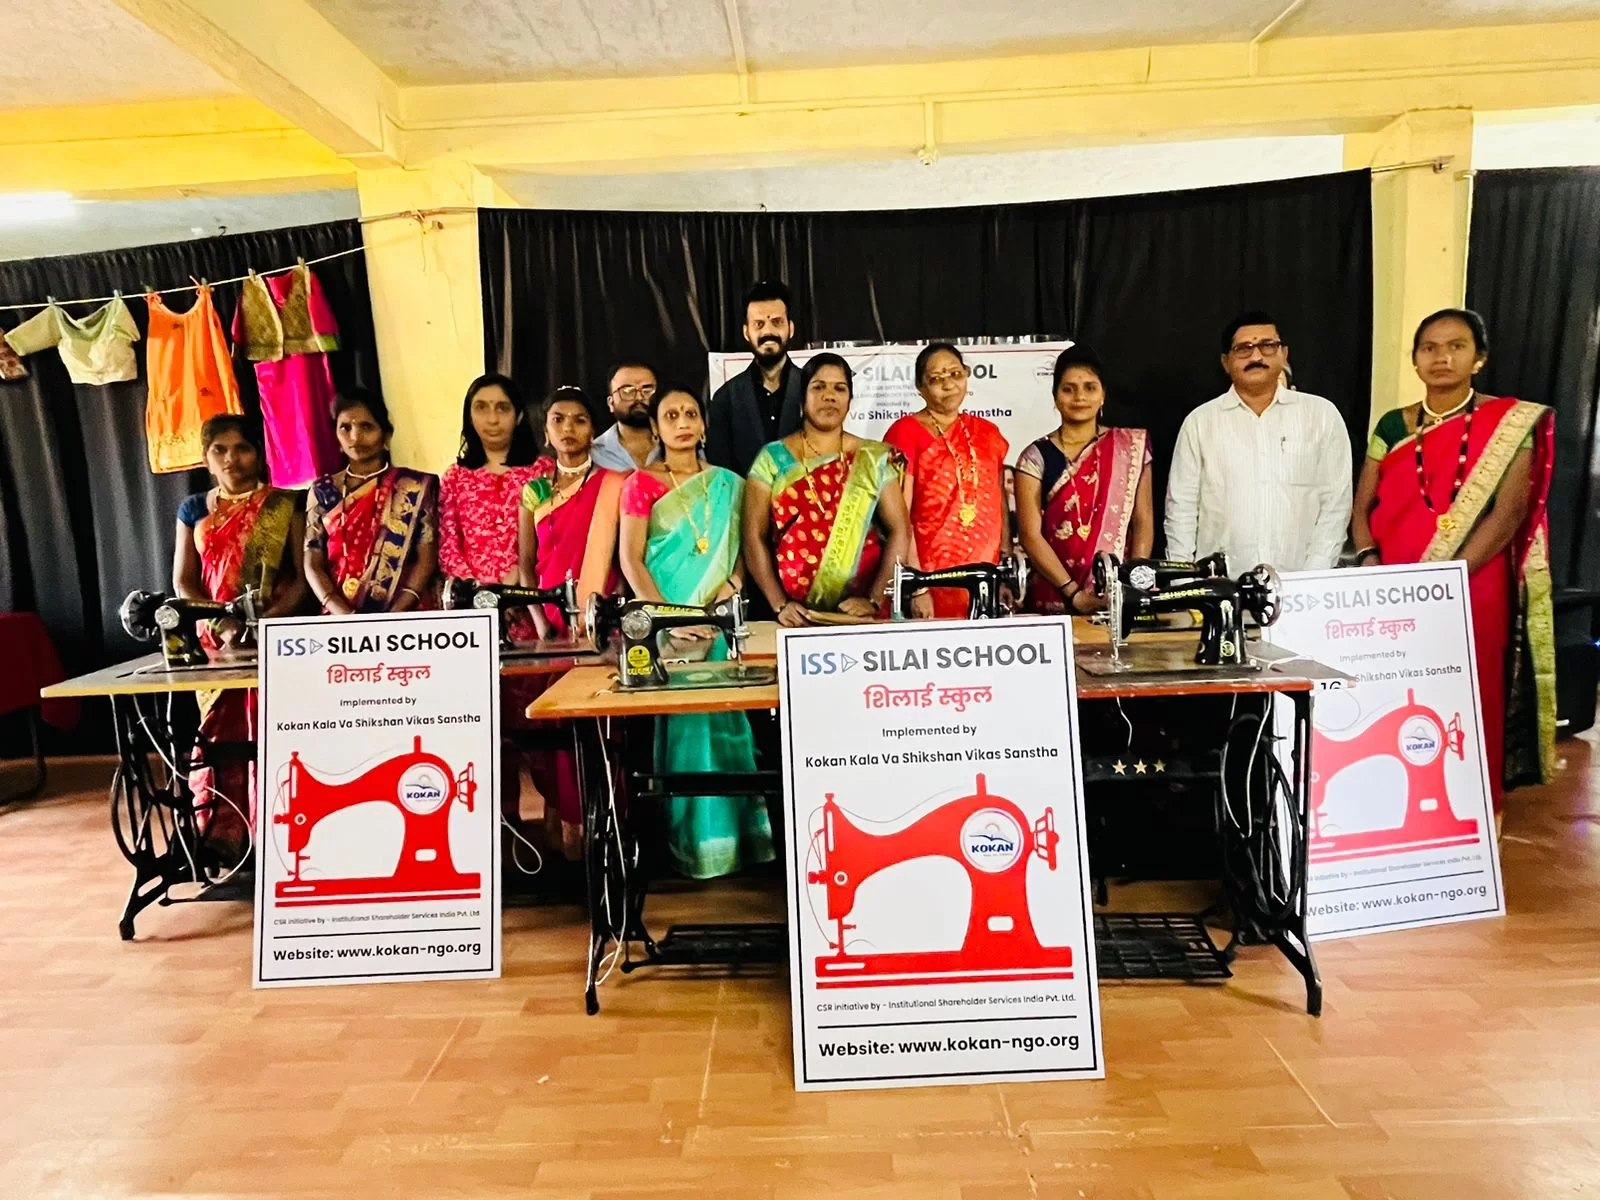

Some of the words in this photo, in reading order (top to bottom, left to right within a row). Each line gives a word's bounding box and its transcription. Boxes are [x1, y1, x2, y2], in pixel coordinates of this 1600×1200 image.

[863, 366, 911, 381] SILAI
[850, 411, 865, 420] Va
[1283, 594, 1305, 613] SS
[1323, 591, 1370, 610] SILAI
[1376, 583, 1454, 605] SCHOOL
[1325, 617, 1376, 640] शिलाई
[277, 638, 306, 656] ISS
[327, 634, 380, 655] SILAI
[387, 631, 480, 651] SCHOOL
[800, 652, 837, 676] ISS
[863, 648, 928, 673] SILAI
[936, 643, 1051, 668] SCHOOL
[1340, 651, 1395, 664] Implemented
[1396, 649, 1406, 661] by
[326, 662, 384, 685] शिलाई
[1399, 668, 1424, 679] Vikas
[1425, 665, 1462, 677] Sanstha
[340, 697, 403, 709] Implemented
[405, 696, 417, 707] by
[863, 682, 935, 710] शिलाई
[277, 721, 310, 732] Kokan
[312, 719, 337, 730] Kala
[339, 719, 353, 729] Va
[355, 717, 404, 728] Shikshan
[406, 715, 435, 726] Vikas
[437, 714, 481, 725] Sanstha
[882, 725, 960, 740] Implemented
[962, 724, 977, 737] by
[1406, 740, 1435, 751] KOKAN
[805, 755, 847, 768] Kokan
[850, 754, 879, 767] Kala
[881, 753, 899, 765] Va
[902, 750, 962, 764] Shikshan
[965, 748, 1001, 761] Vikas
[1004, 746, 1058, 760] Sanstha
[406, 790, 441, 799] KOKAN
[971, 843, 1014, 853] KOKAN
[1362, 885, 1487, 910] www.kokan-ngo.org
[274, 947, 334, 961] Website:
[337, 943, 481, 959] www.kokan-ngo.org
[816, 1003, 833, 1012] CSR
[834, 1002, 869, 1011] initiative
[870, 1002, 880, 1011] by
[888, 999, 937, 1009] Institutional
[939, 997, 987, 1007] Shareholder
[988, 996, 1021, 1005] Services
[1023, 994, 1044, 1003] India
[1045, 994, 1060, 1002] Pvt.
[1062, 994, 1077, 1002] Ltd.
[819, 1040, 895, 1057] Website:
[898, 1033, 1080, 1053] www.kokan-ngo.org
